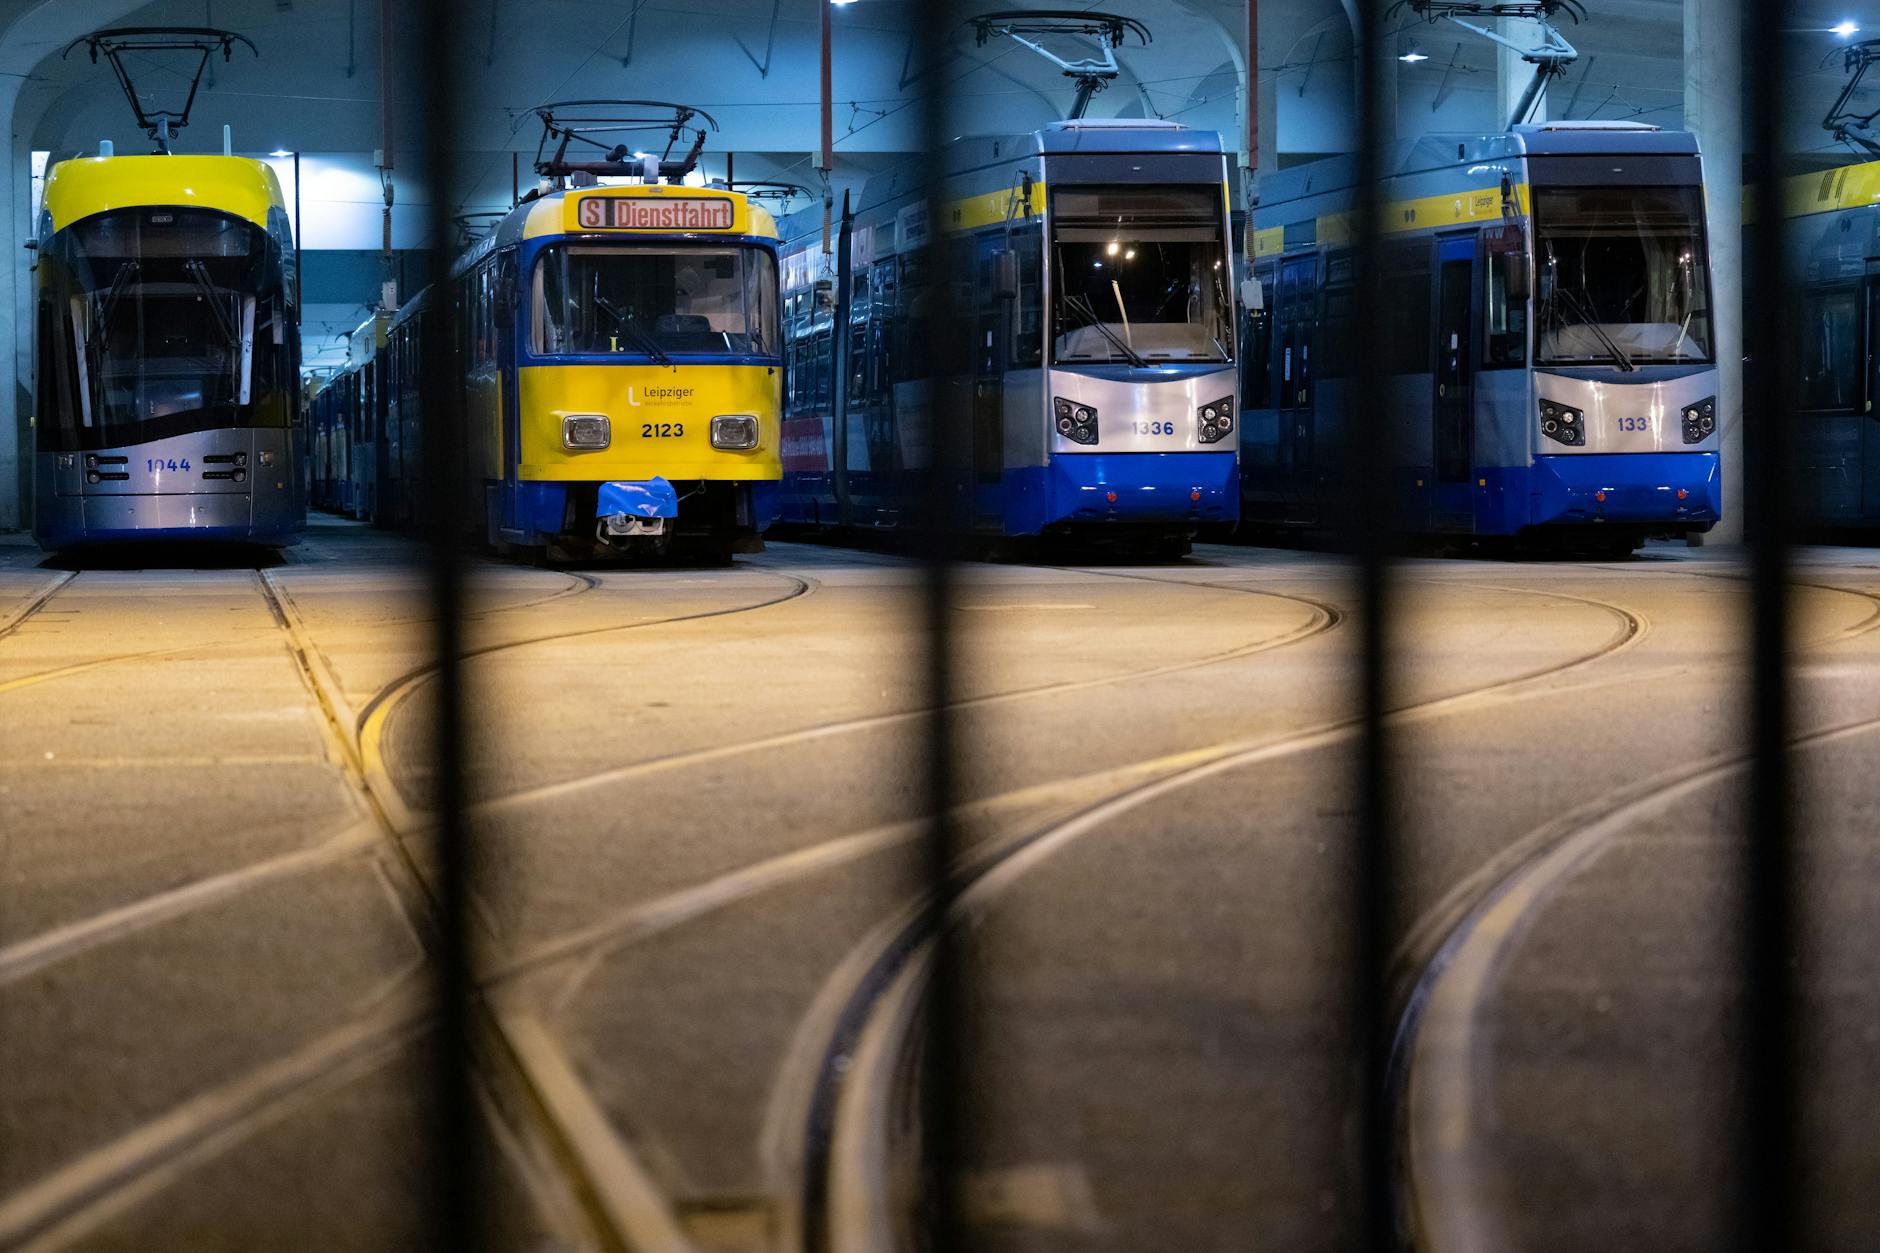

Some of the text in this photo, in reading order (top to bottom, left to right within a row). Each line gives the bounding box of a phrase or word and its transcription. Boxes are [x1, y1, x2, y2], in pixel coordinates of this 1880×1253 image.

[586, 200, 729, 227] S Dienstfahrt
[644, 386, 694, 399] Leipziger
[641, 423, 684, 438] 2123
[1132, 421, 1174, 436] 1336
[147, 458, 191, 473] 1044
